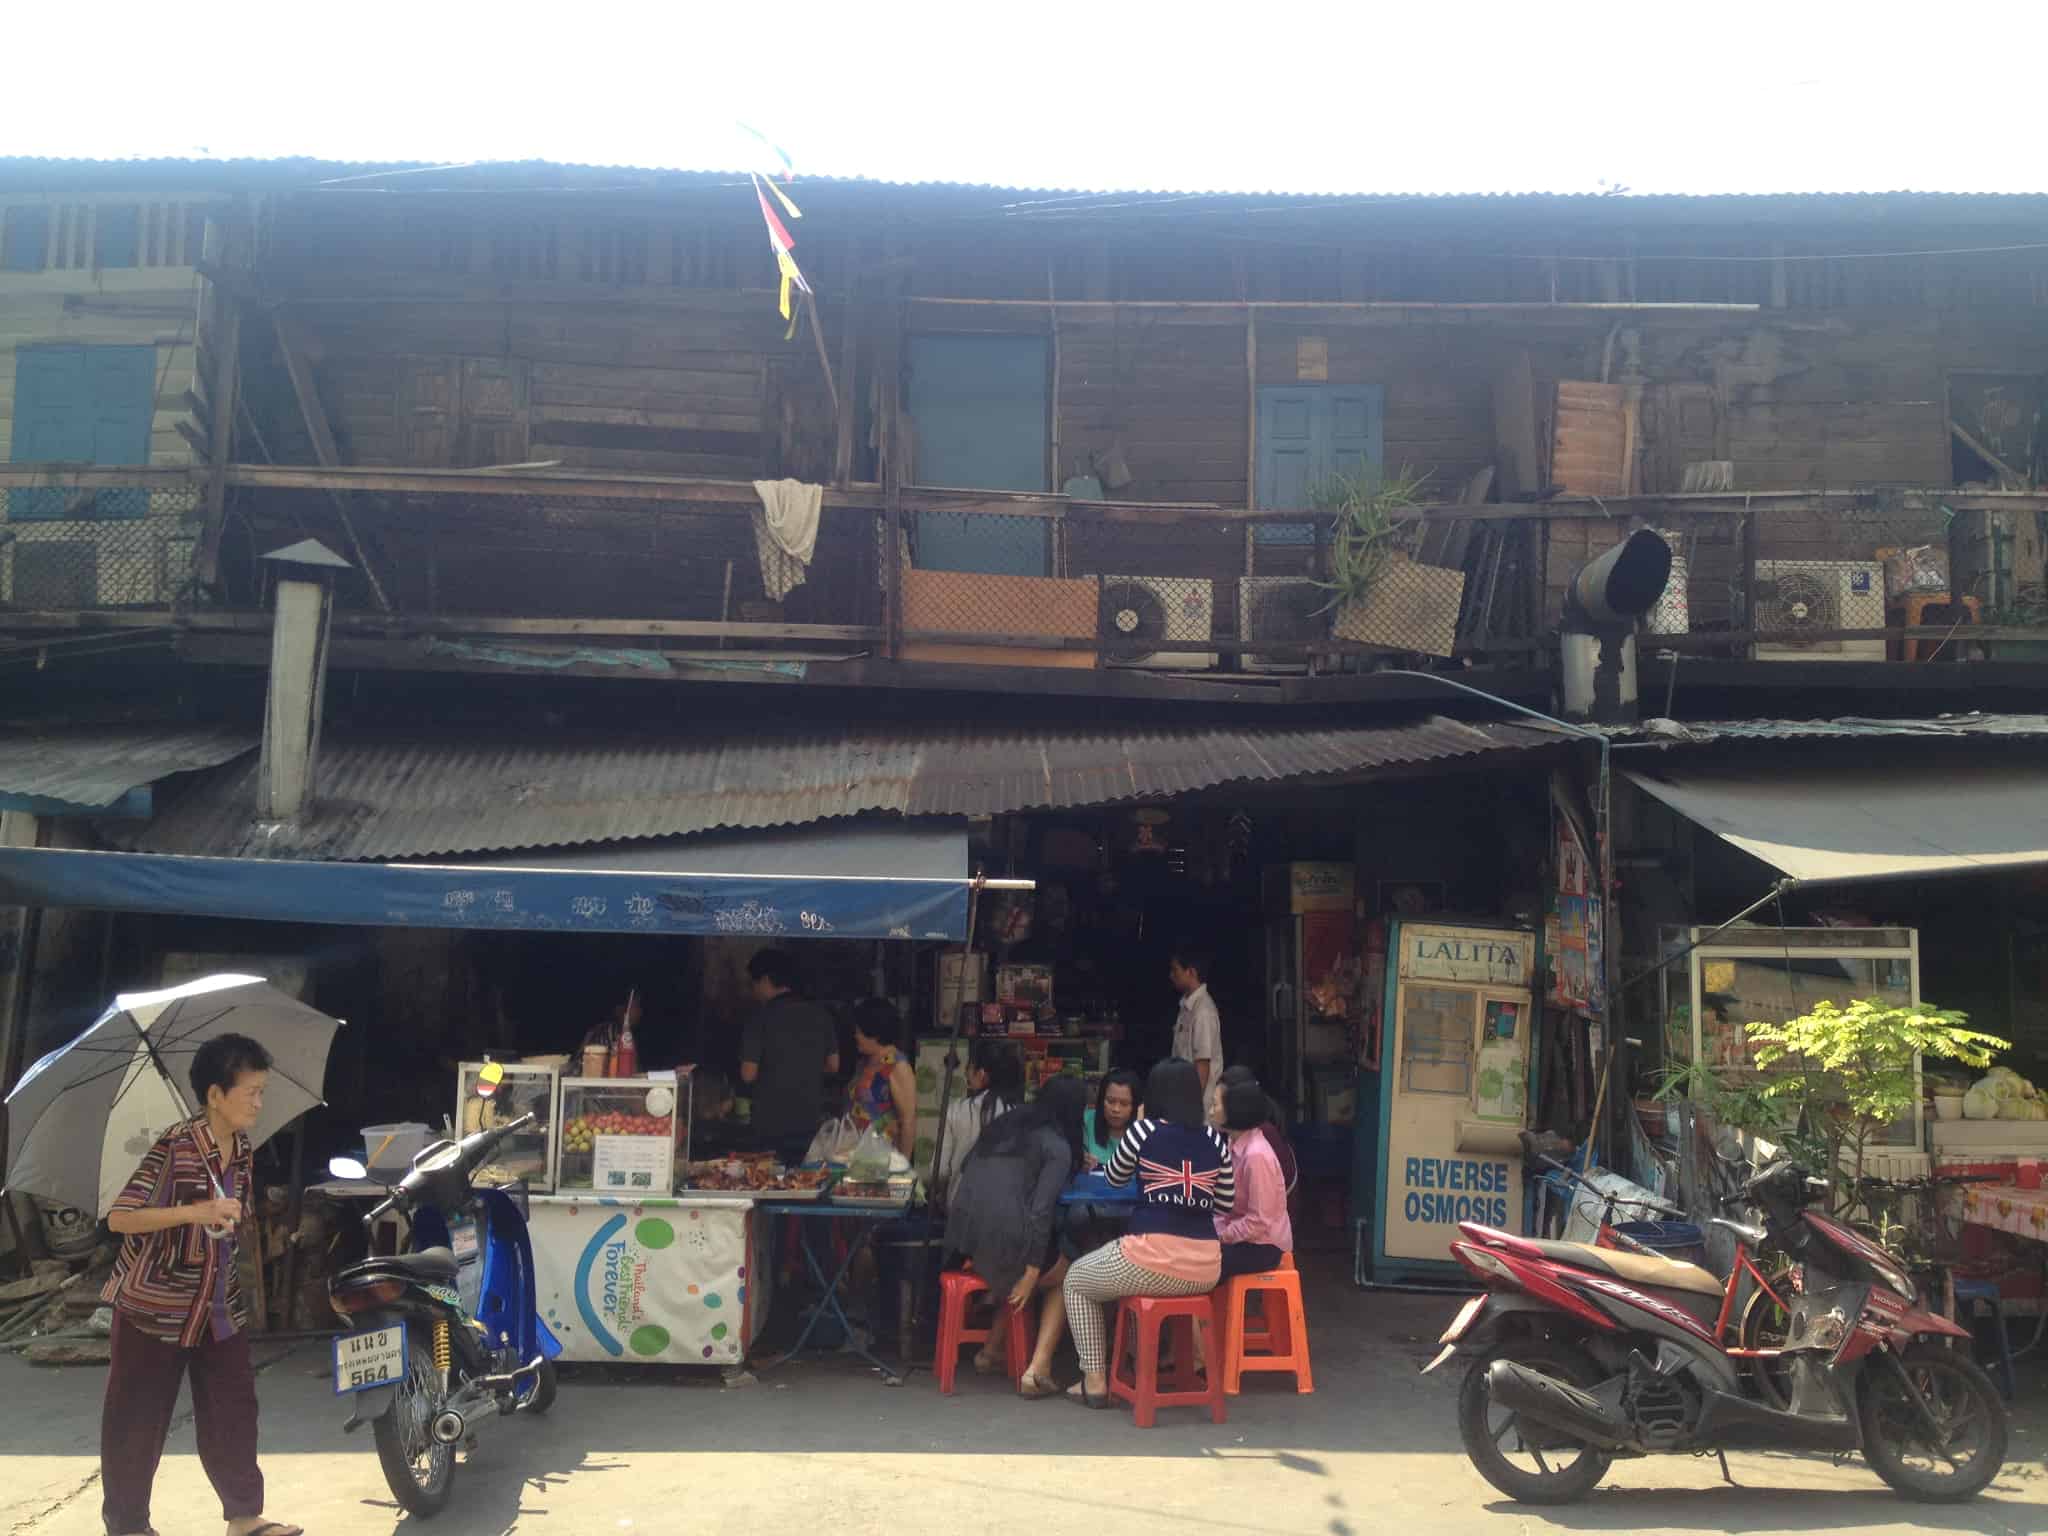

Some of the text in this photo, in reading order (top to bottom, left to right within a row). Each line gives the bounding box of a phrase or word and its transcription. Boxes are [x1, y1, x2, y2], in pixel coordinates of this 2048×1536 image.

[1417, 940, 1516, 964] LALITA
[1405, 1157, 1508, 1192] REVERSE
[1405, 1191, 1506, 1227] OSMOSIS
[604, 1240, 626, 1313] Forever
[351, 1365, 388, 1386] 564
